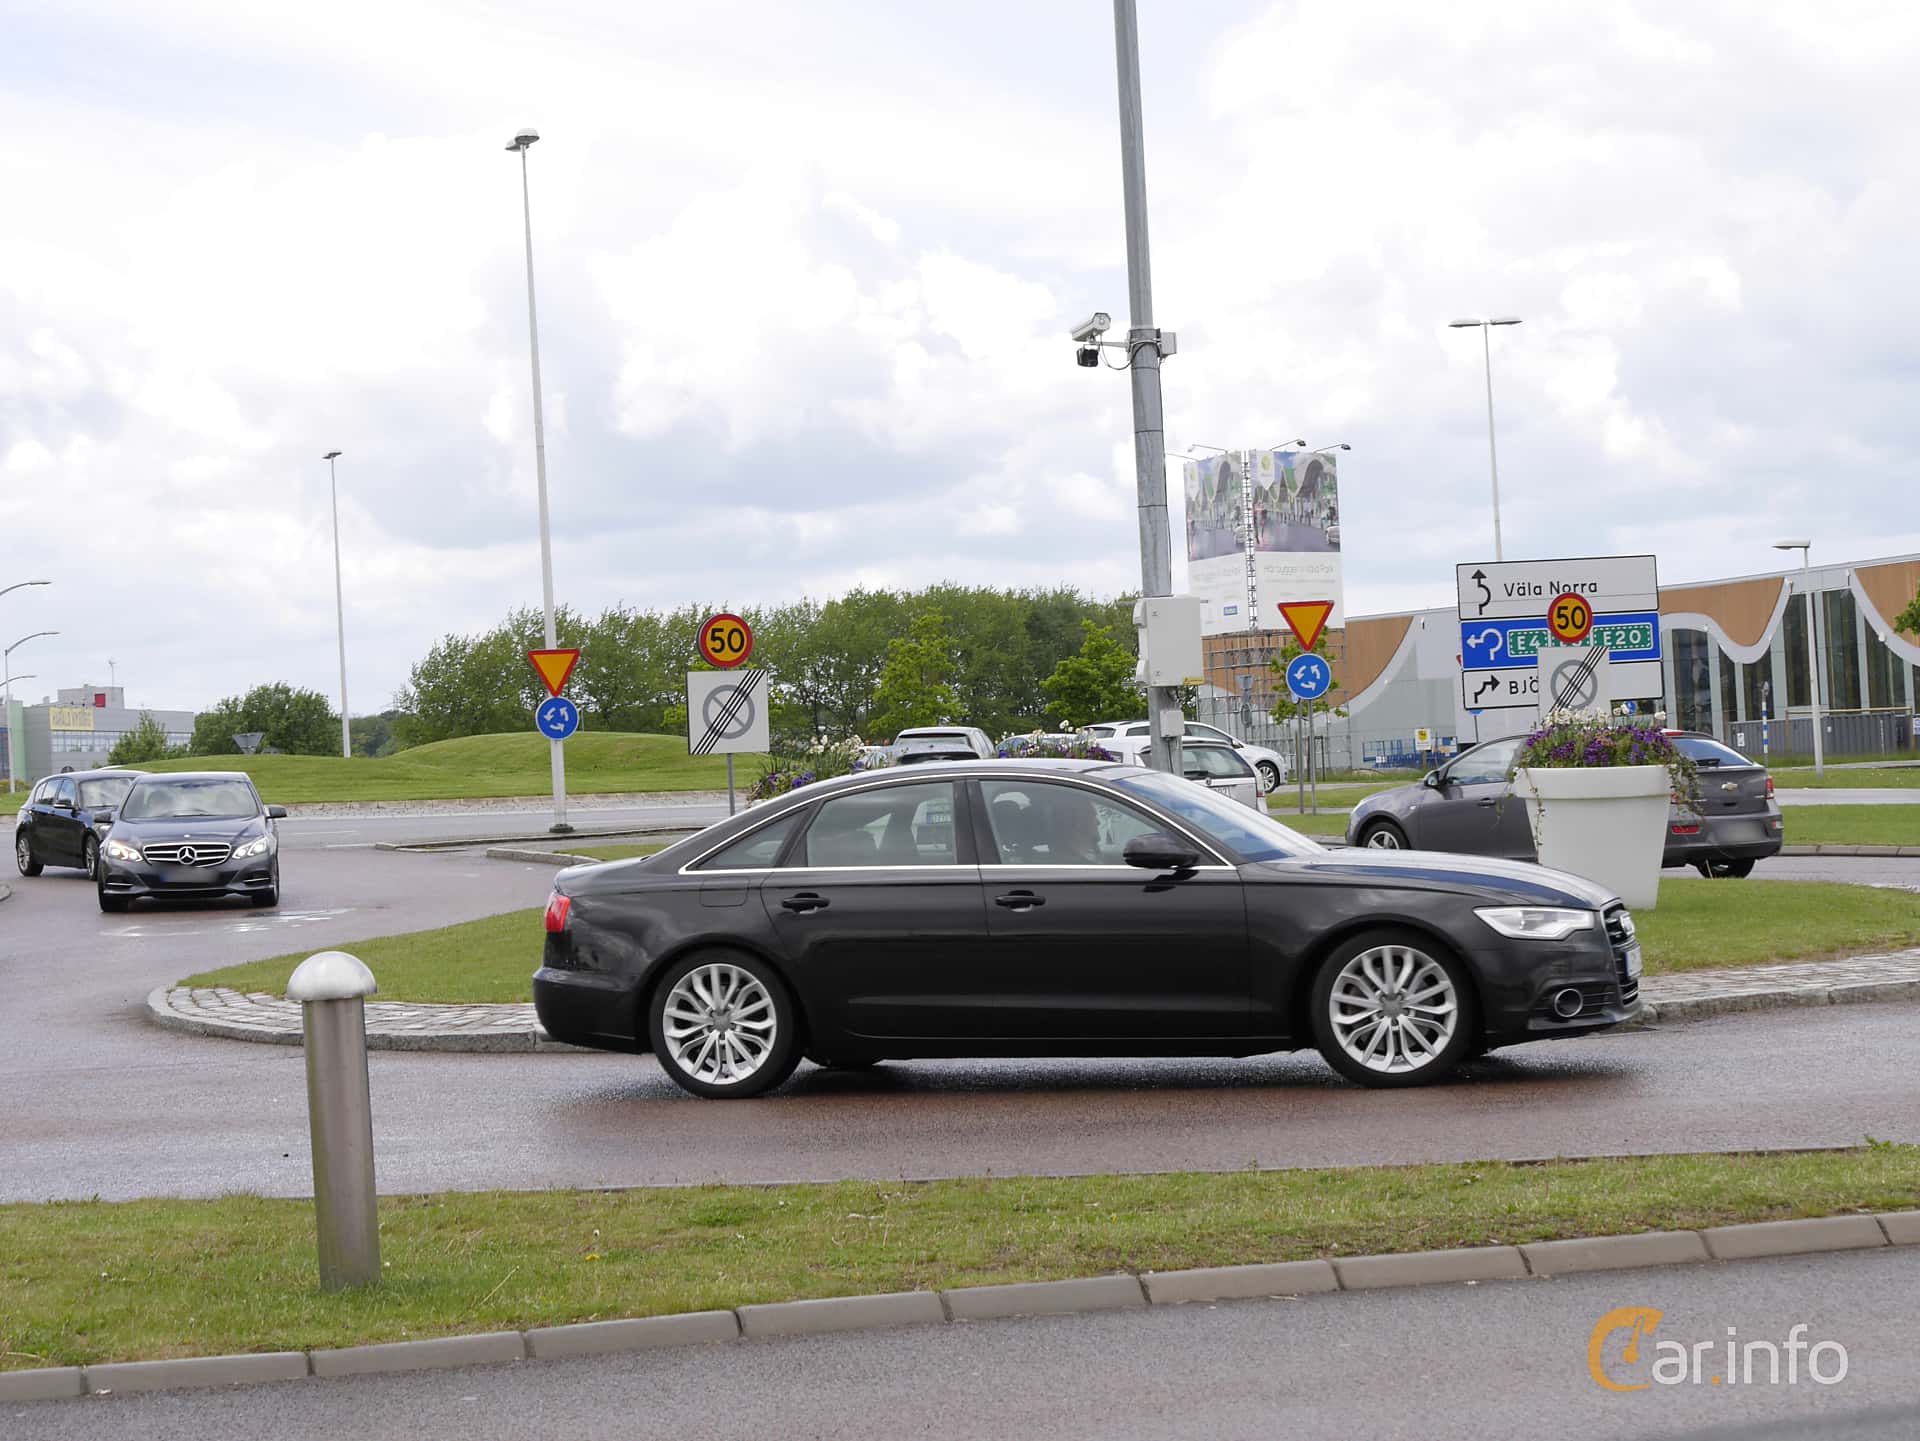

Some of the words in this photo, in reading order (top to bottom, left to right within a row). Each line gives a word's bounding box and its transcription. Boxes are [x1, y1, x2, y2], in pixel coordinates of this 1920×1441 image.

[1504, 583, 1542, 597] Väla
[1549, 581, 1598, 595] Norra
[1556, 606, 1586, 630] 50
[710, 628, 745, 653] 50
[1517, 634, 1540, 651] E4
[1603, 630, 1642, 646] E20
